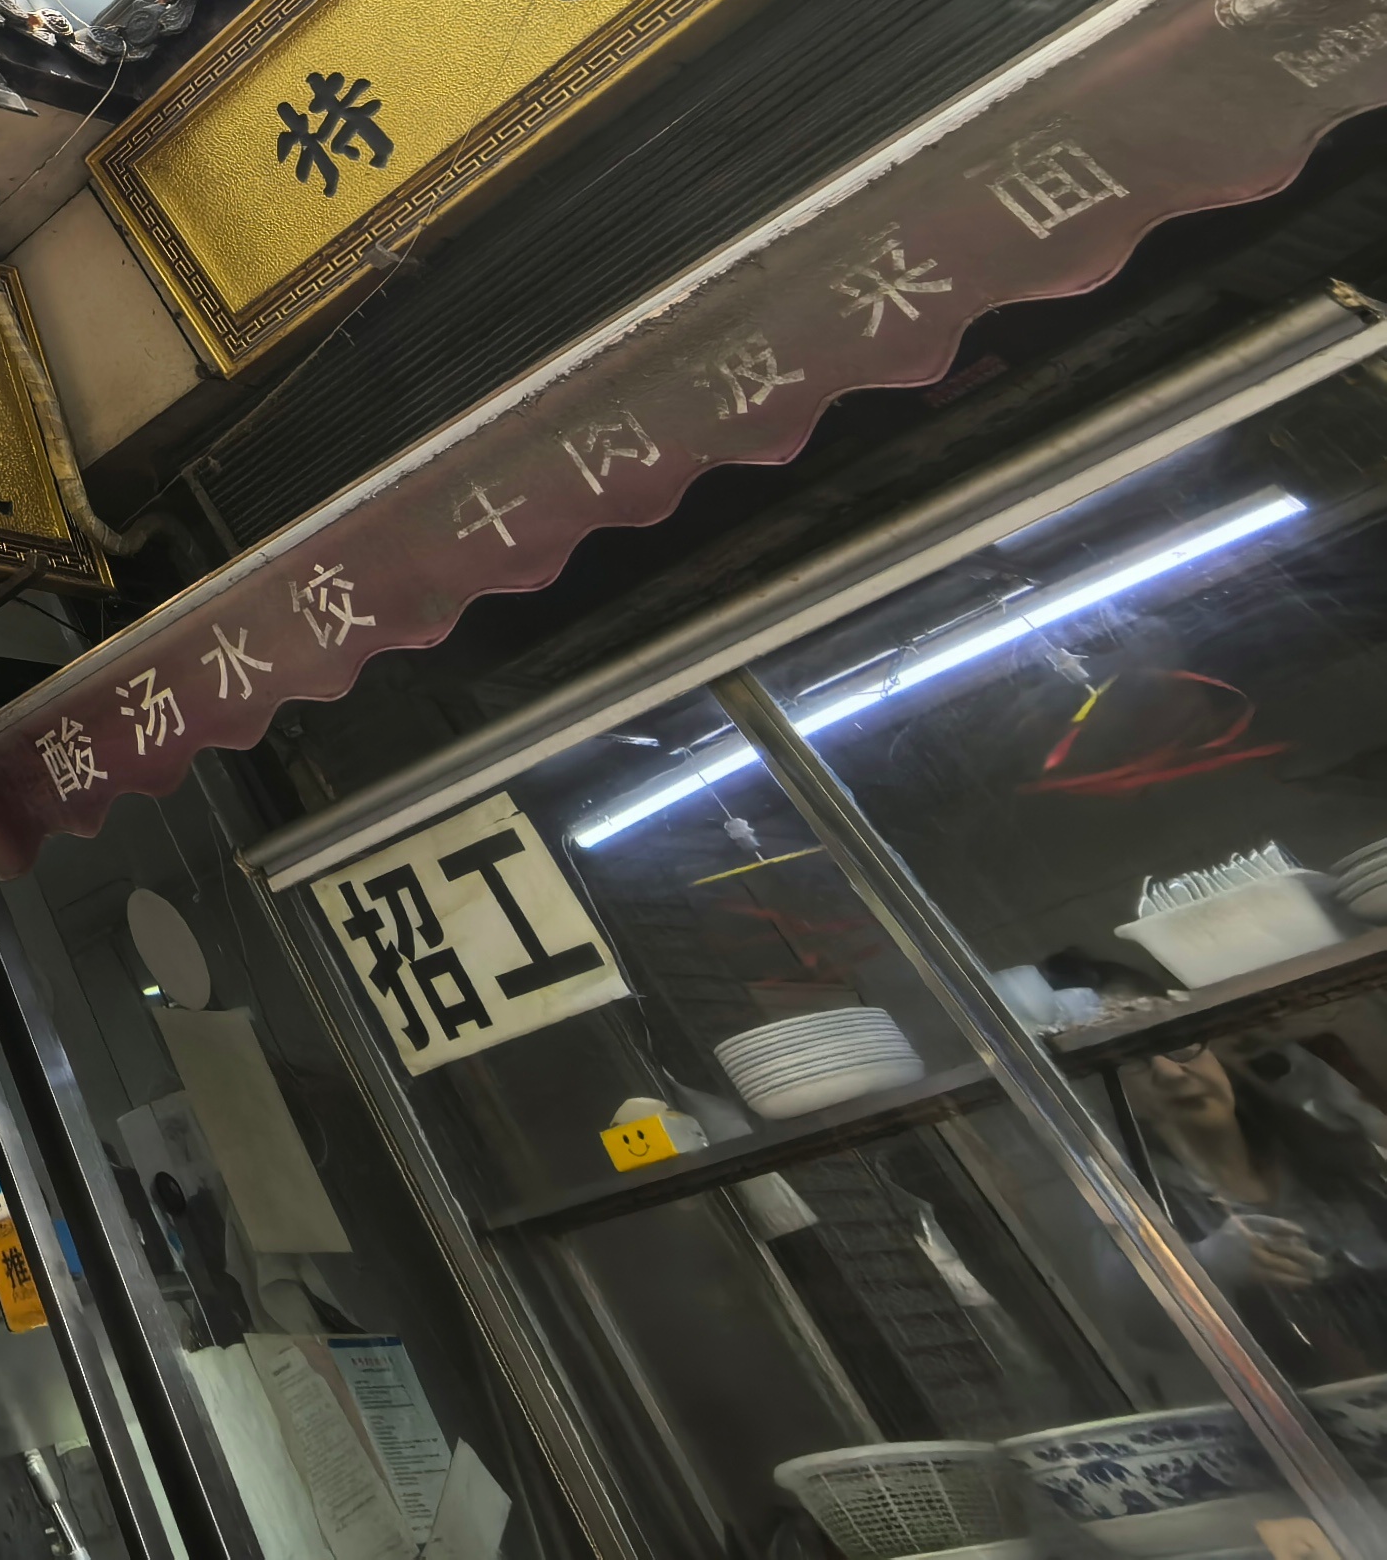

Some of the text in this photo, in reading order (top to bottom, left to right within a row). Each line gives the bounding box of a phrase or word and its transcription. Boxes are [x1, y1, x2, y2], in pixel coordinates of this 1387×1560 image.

[35, 564, 376, 802] 酸汤水饺
[342, 827, 605, 1052] 招工
[2, 1246, 31, 1288] 推
